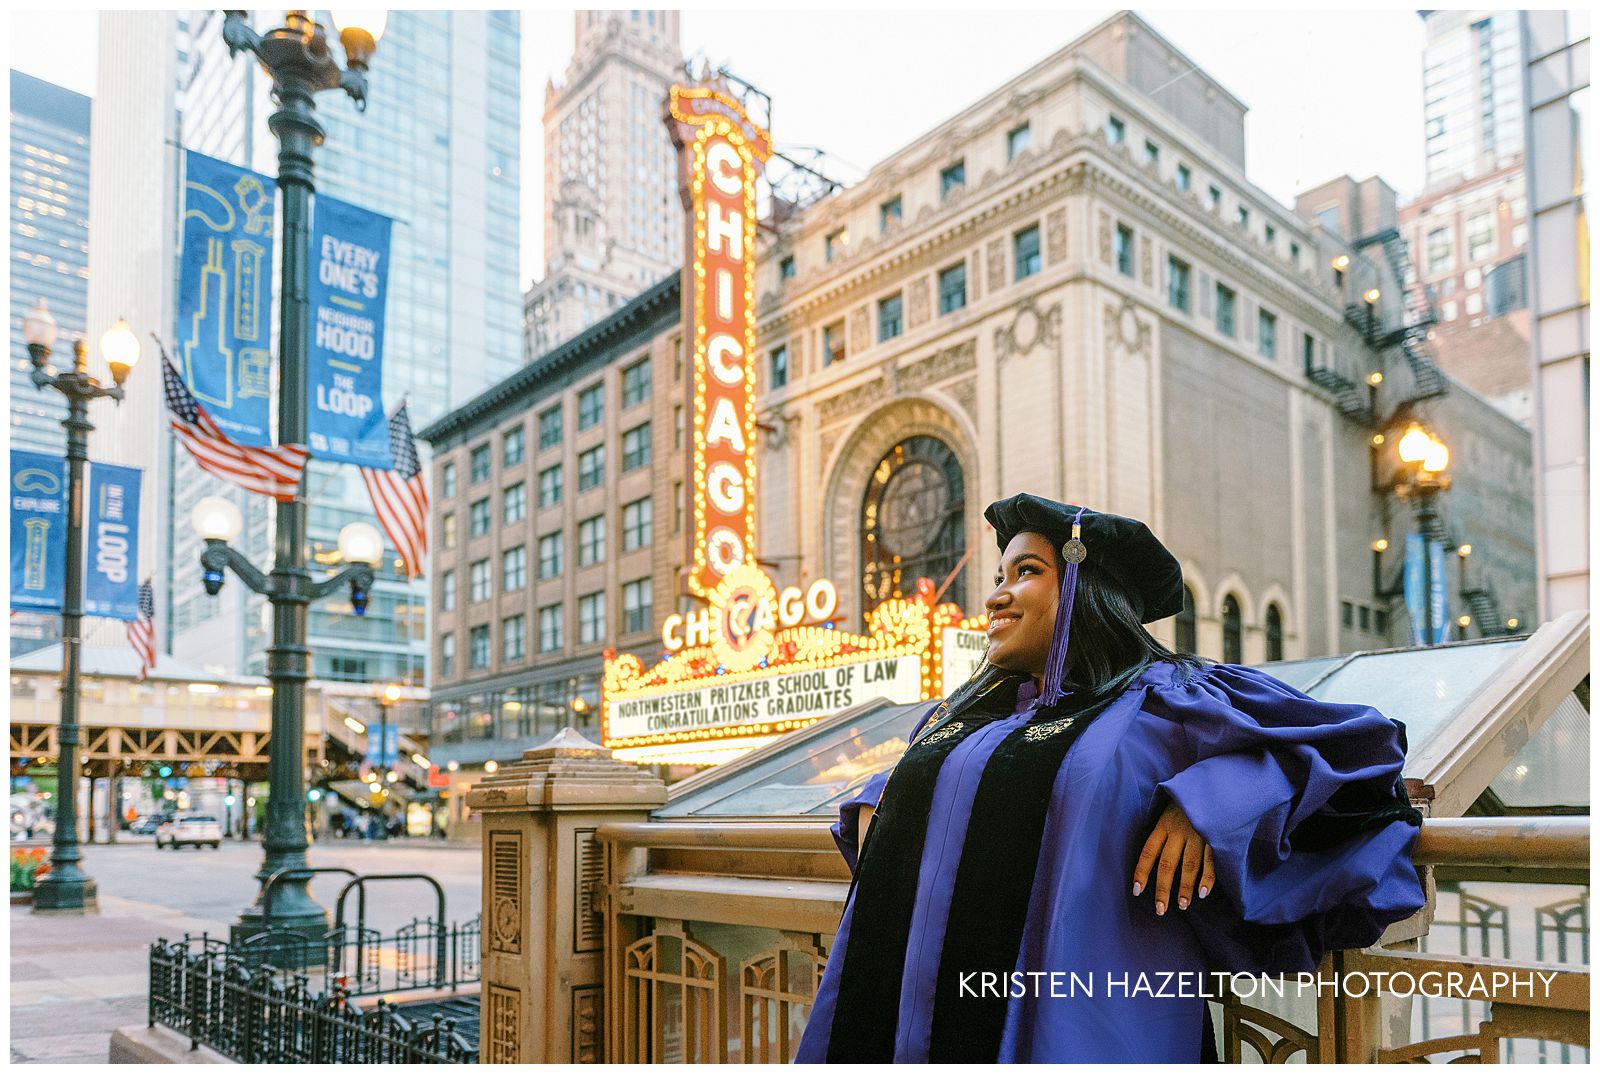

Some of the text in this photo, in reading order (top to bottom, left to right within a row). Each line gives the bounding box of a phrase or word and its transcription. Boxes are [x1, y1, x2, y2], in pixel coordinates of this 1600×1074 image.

[321, 234, 380, 272] EVERY
[319, 258, 378, 298] ONE'S
[316, 321, 375, 361] HOOD
[705, 139, 745, 576] CHICAGO
[316, 384, 374, 419] LOOP
[333, 373, 354, 390] THE
[13, 496, 60, 513] EXPLORE
[107, 484, 124, 519] IN THE
[97, 522, 130, 583] LOOP
[662, 578, 837, 650] CHICAGO
[618, 659, 898, 719] NORTHWESTERN PRITZKER SCHOOL OF LAW
[647, 688, 853, 731] CONGRATULATIONS GRADUATES
